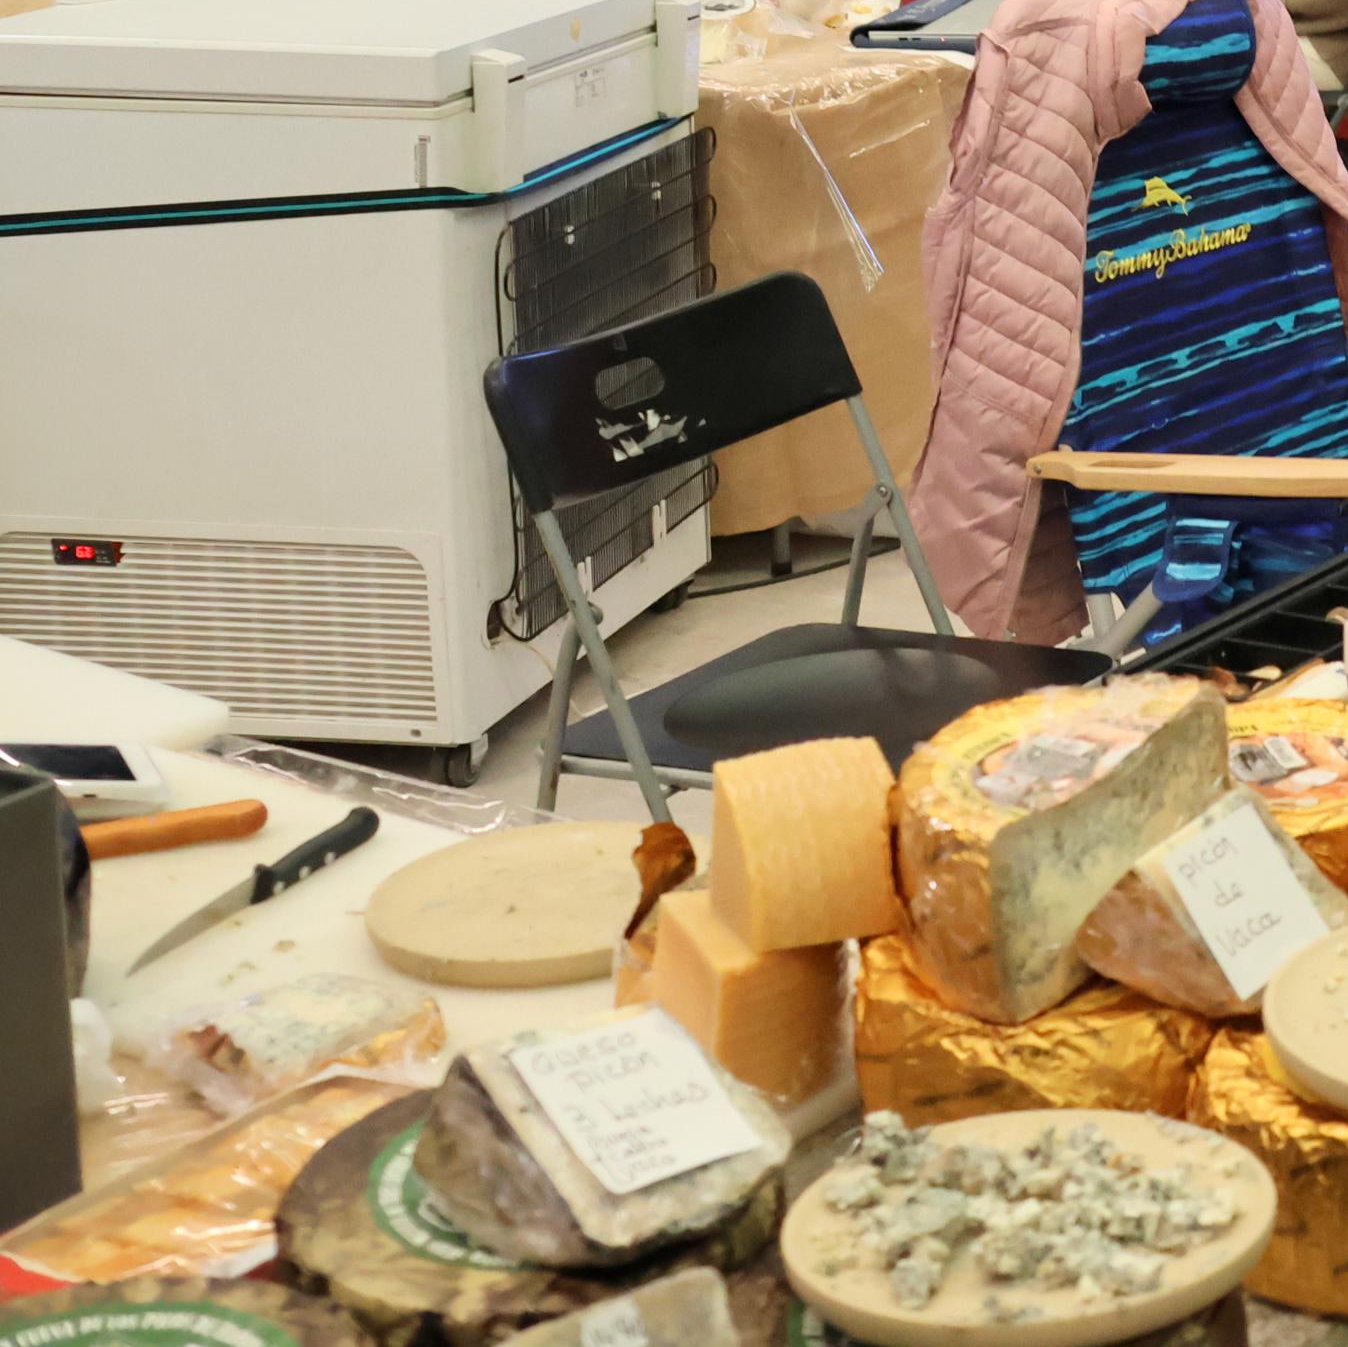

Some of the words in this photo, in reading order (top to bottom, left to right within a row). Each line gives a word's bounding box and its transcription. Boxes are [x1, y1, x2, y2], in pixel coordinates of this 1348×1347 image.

[1095, 249, 1167, 283] Tommy
[1165, 234, 1251, 263] Bahama
[1213, 881, 1245, 908] de
